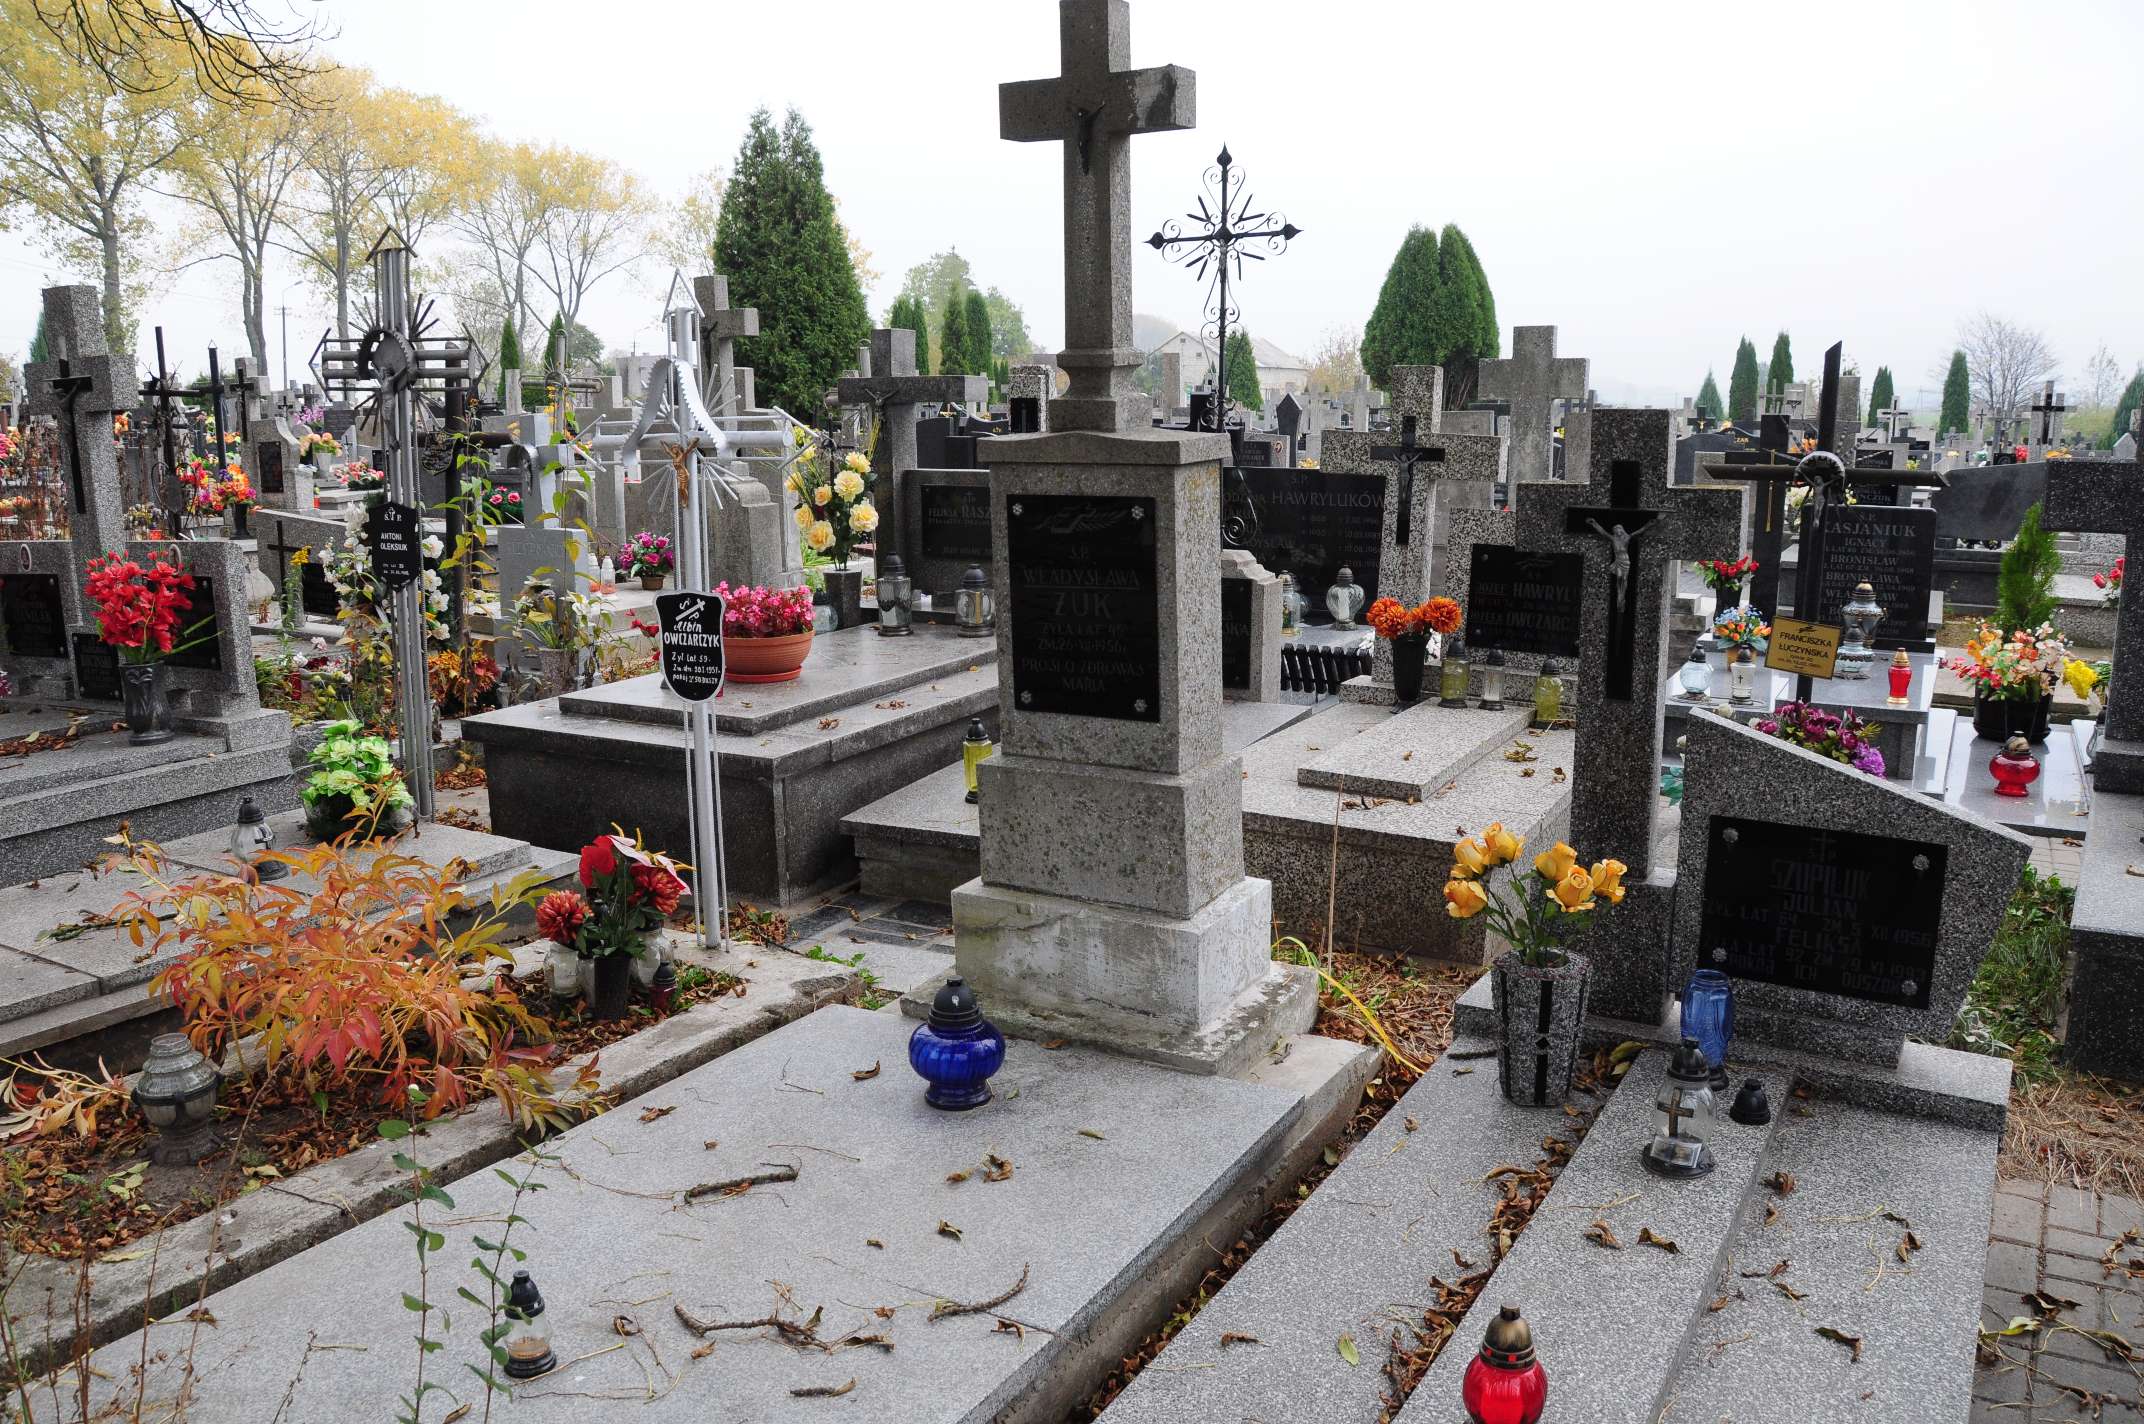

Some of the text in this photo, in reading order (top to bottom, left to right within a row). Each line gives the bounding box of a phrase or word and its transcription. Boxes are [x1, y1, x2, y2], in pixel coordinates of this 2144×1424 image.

[1271, 488, 1384, 508] HAWRYLUKÓW
[380, 532, 402, 541] ANTONI
[1844, 537, 1888, 548] IGNACY
[380, 542, 408, 551] OLEKSIUK
[1023, 567, 1141, 586] WŁADYSŁAWA
[674, 621, 702, 633] Albin
[663, 632, 720, 648] OWCZARCZYK
[1779, 632, 1832, 647] FRANCISZKA
[1740, 904, 1768, 923] LAT
[1783, 892, 1858, 920] JULIAN
[1775, 927, 1863, 956] FELIKSA
[1794, 964, 1817, 981] ICH
